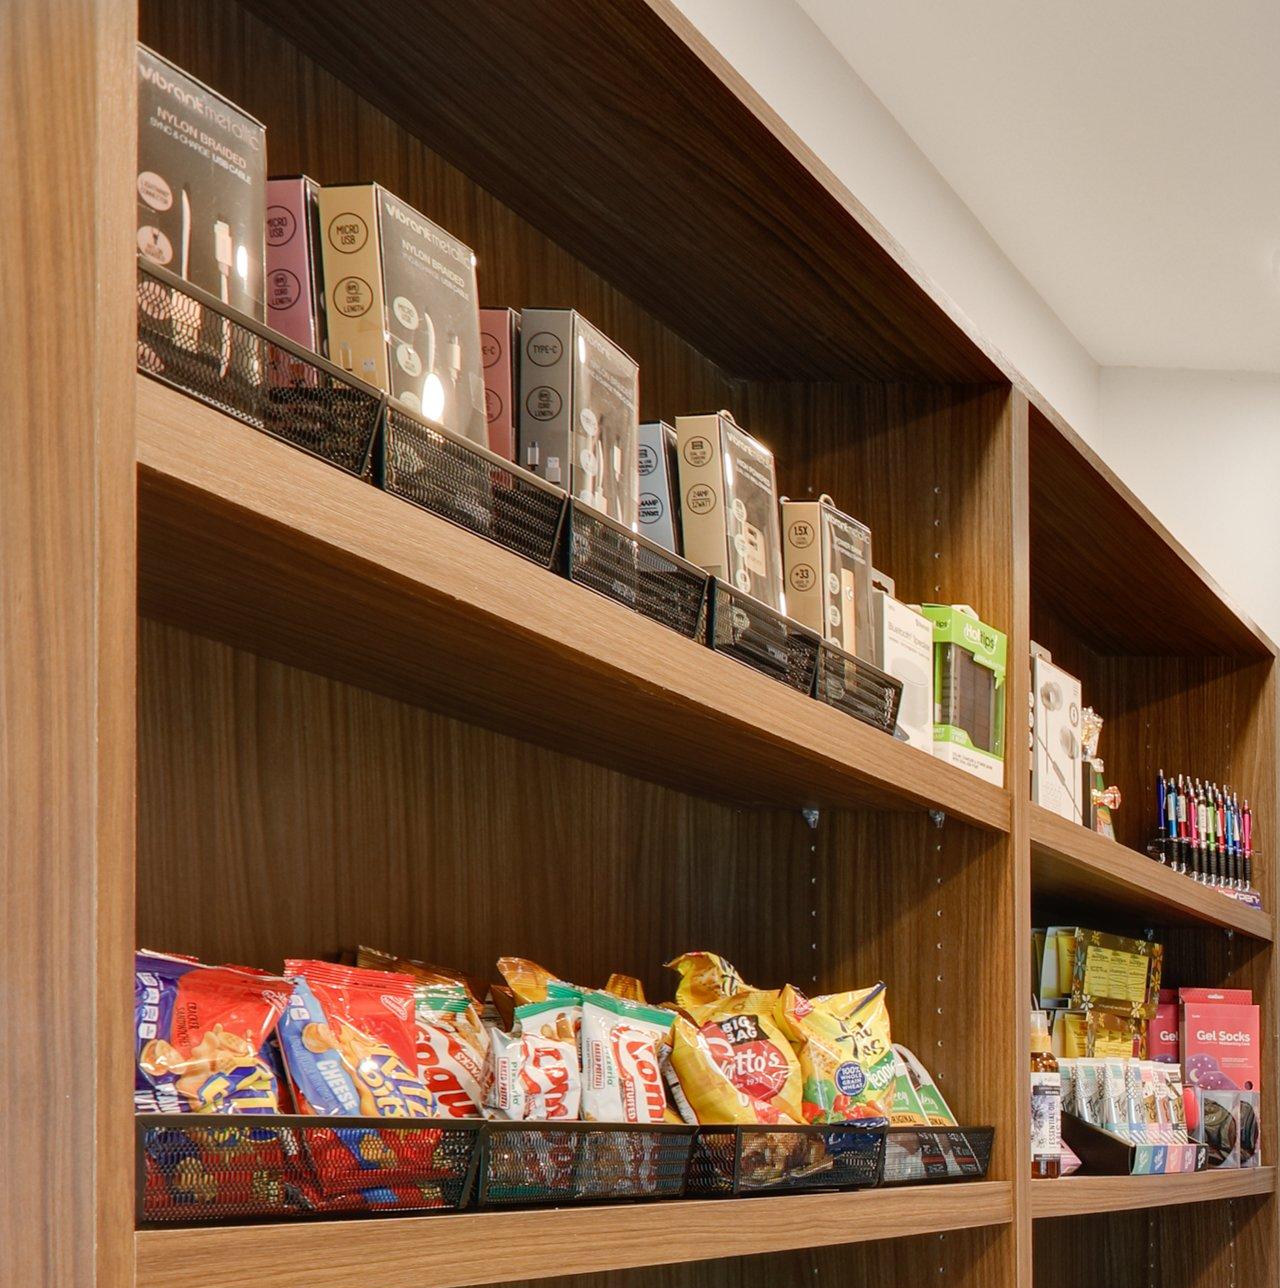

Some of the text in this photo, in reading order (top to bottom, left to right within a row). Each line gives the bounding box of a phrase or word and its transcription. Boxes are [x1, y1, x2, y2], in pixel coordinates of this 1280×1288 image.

[157, 106, 247, 169] NYLON BRAIDED
[336, 224, 360, 236] MICRO
[341, 234, 356, 246] USB
[431, 259, 465, 288] BRAIDED
[533, 344, 557, 355] TYPE-C
[187, 1001, 198, 1030] CRACKER
[721, 1016, 750, 1034] BIG
[1160, 1030, 1179, 1042] Gel
[1196, 1030, 1251, 1043] Gel Socks
[841, 1072, 863, 1081] WHOLE
[842, 1066, 860, 1076] 100%
[316, 1059, 358, 1110] CHEESE
[842, 1077, 863, 1086] GRAIN
[843, 1083, 863, 1091] WHEAT
